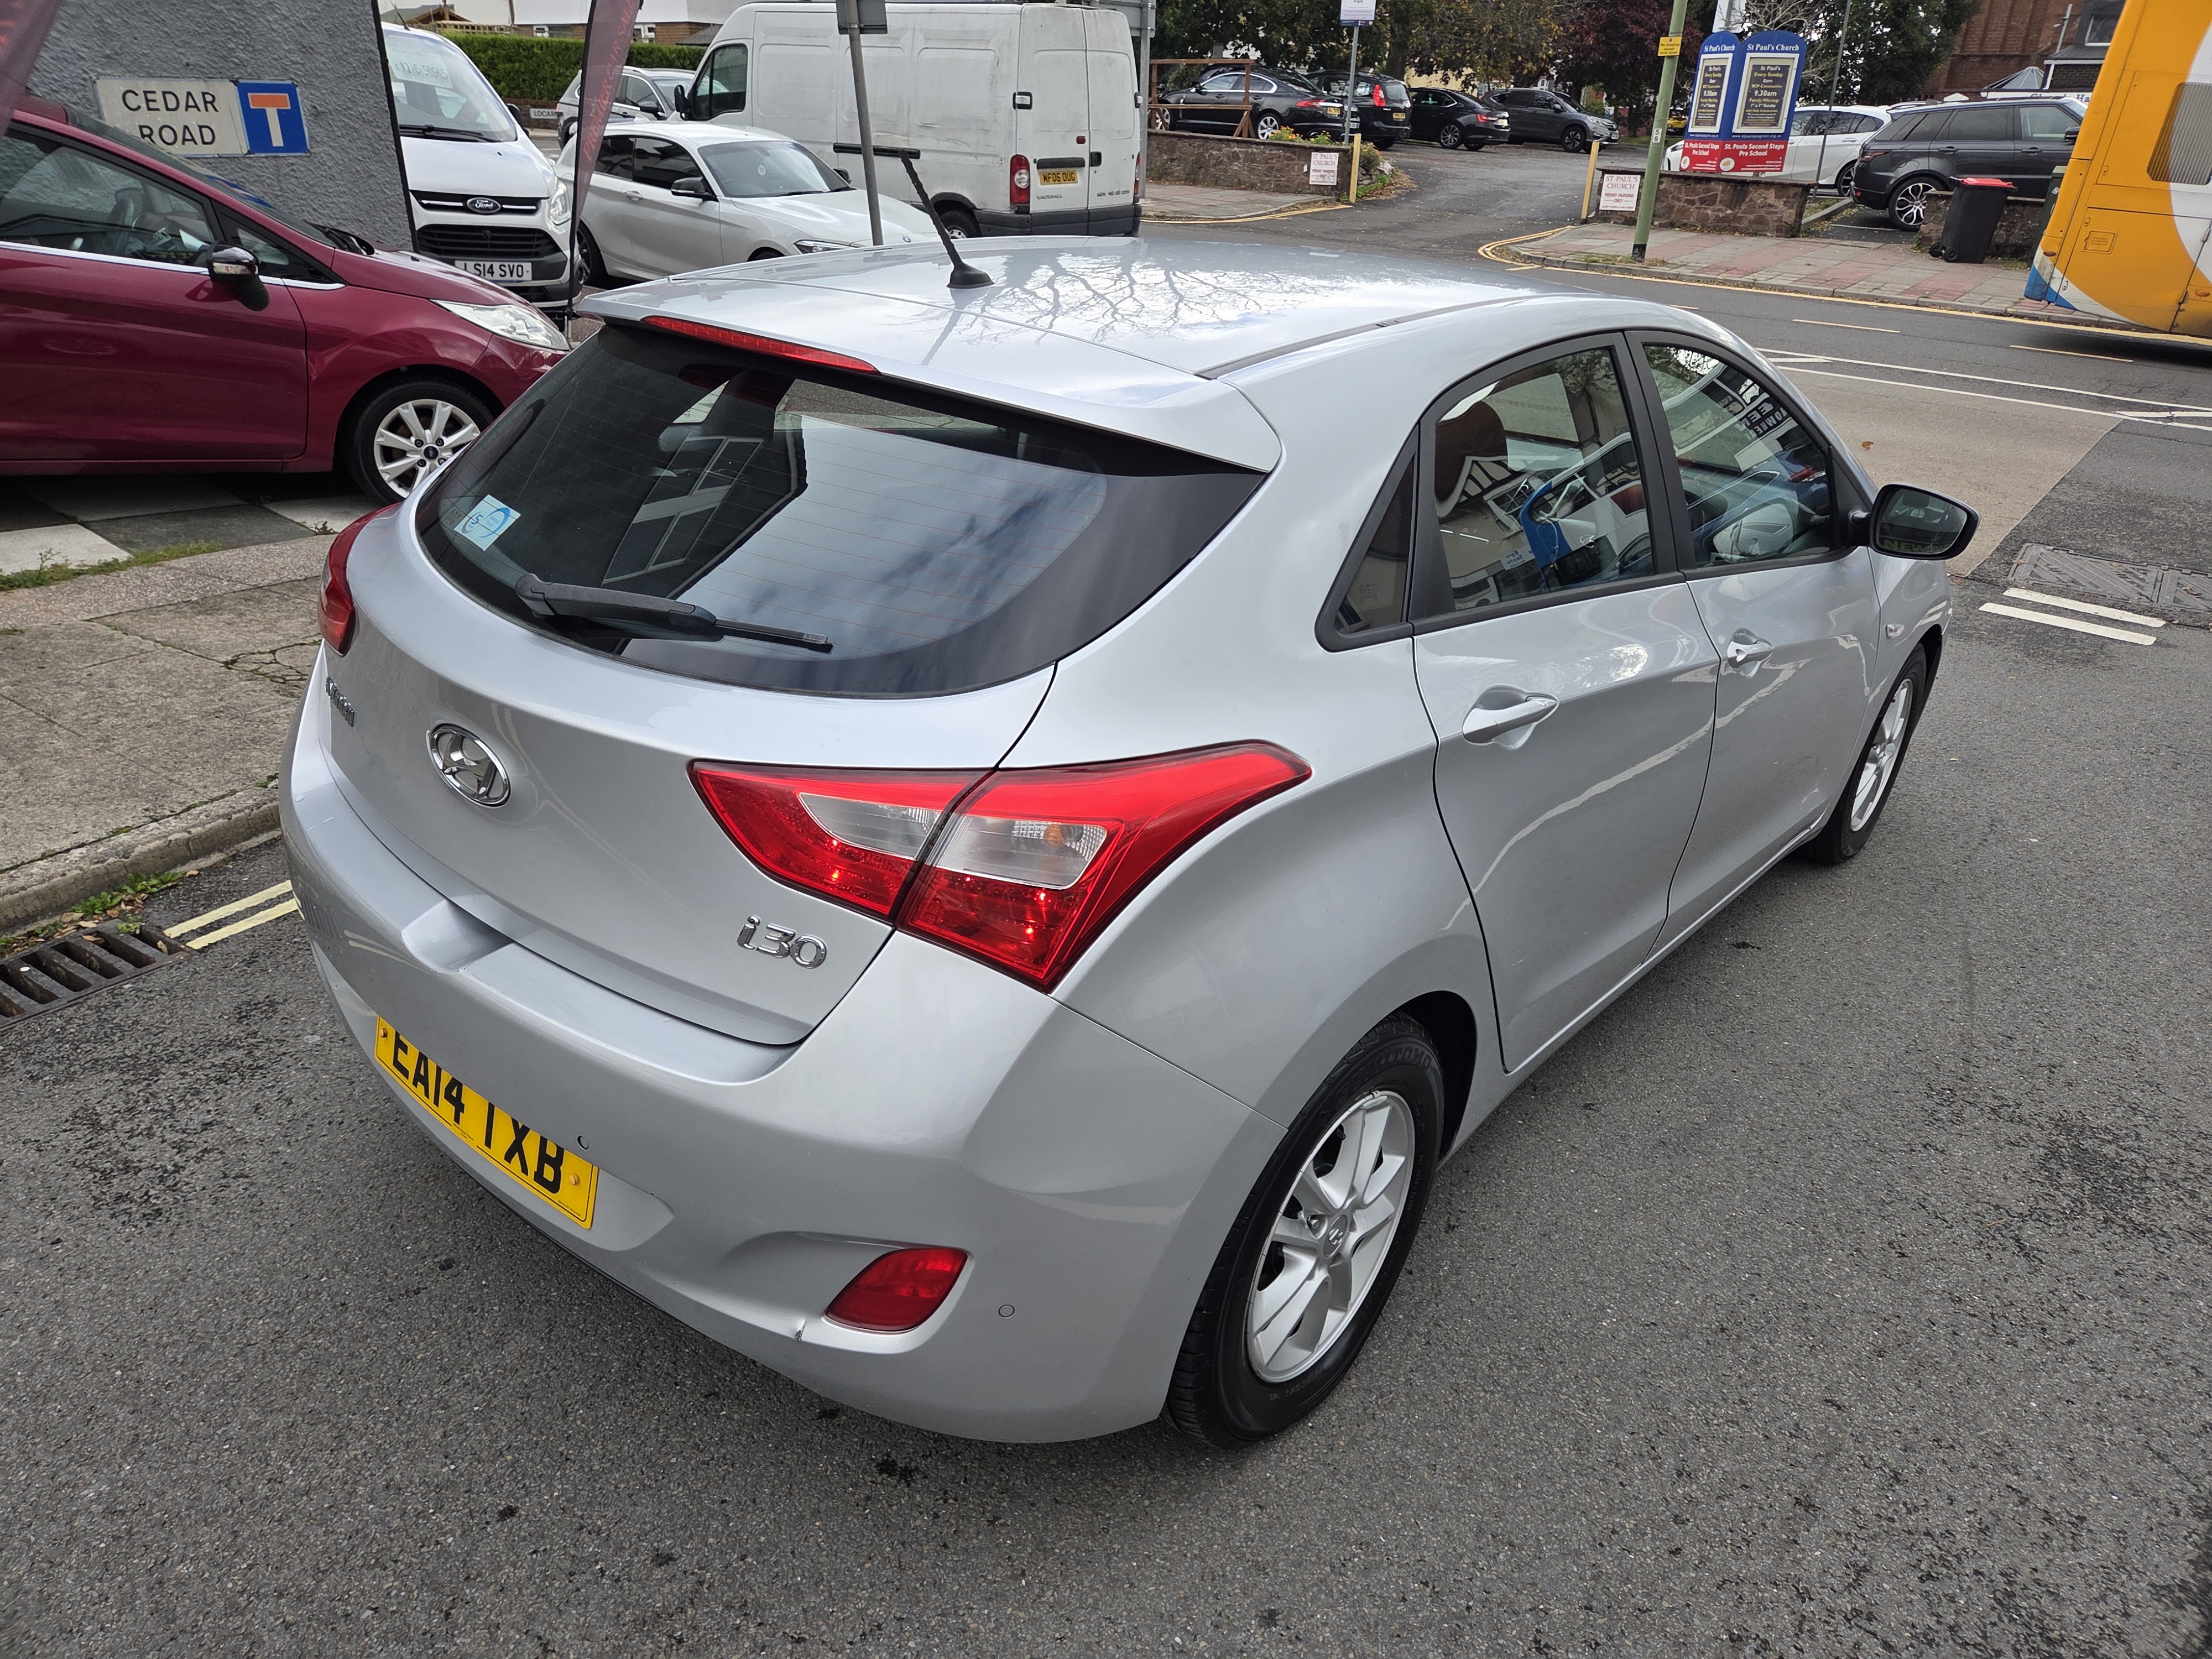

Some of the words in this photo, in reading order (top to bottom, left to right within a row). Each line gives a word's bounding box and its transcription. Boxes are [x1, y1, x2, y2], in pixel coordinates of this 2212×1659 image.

[121, 89, 219, 112] CEDAR
[583, 78, 613, 163] PREMIER
[606, 40, 622, 81] CAR
[138, 124, 216, 146] ROAD
[736, 915, 827, 969] i30
[392, 1030, 466, 1125] EA14
